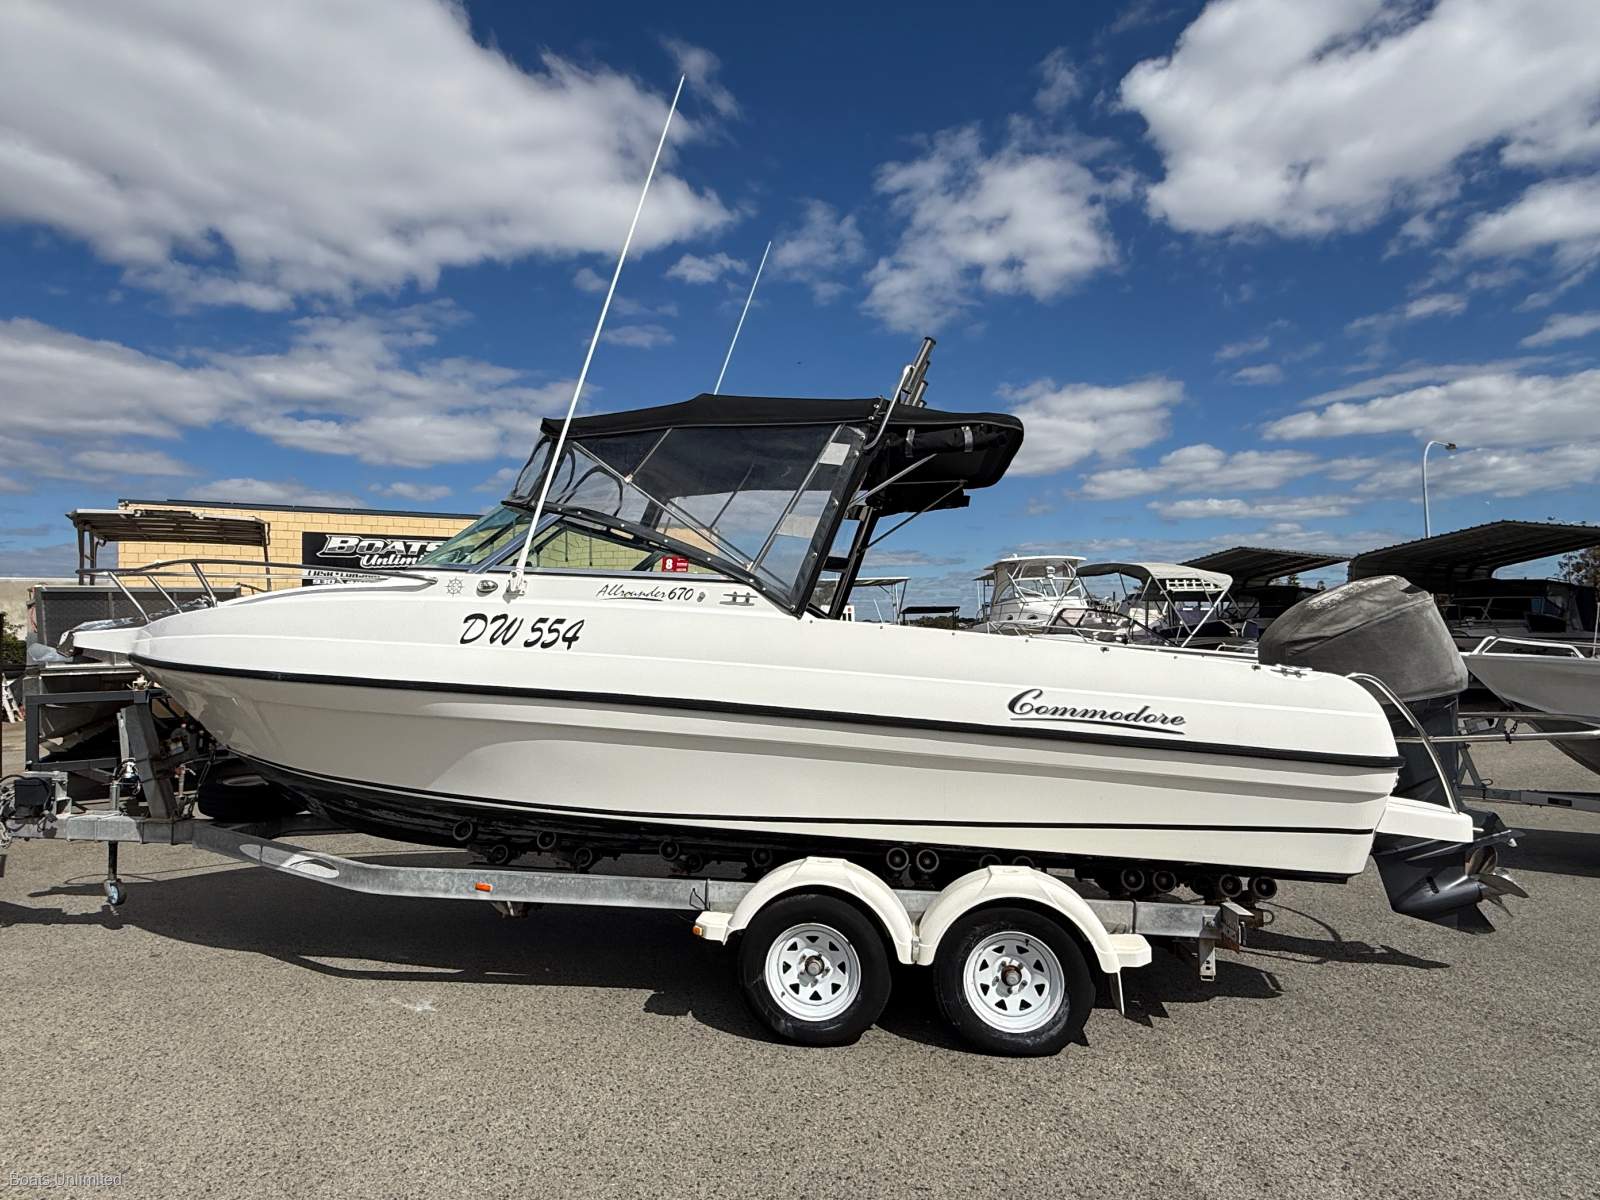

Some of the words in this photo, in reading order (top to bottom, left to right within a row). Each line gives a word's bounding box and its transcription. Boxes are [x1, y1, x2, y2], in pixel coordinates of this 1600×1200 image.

[319, 535, 446, 556] BOATS
[361, 554, 425, 568] Unlimi
[665, 558, 674, 570] 8
[596, 584, 666, 599] Allrounder
[667, 587, 694, 601] 670
[459, 612, 524, 646] DW
[523, 617, 585, 651] 554
[1007, 688, 1187, 726] Commodore
